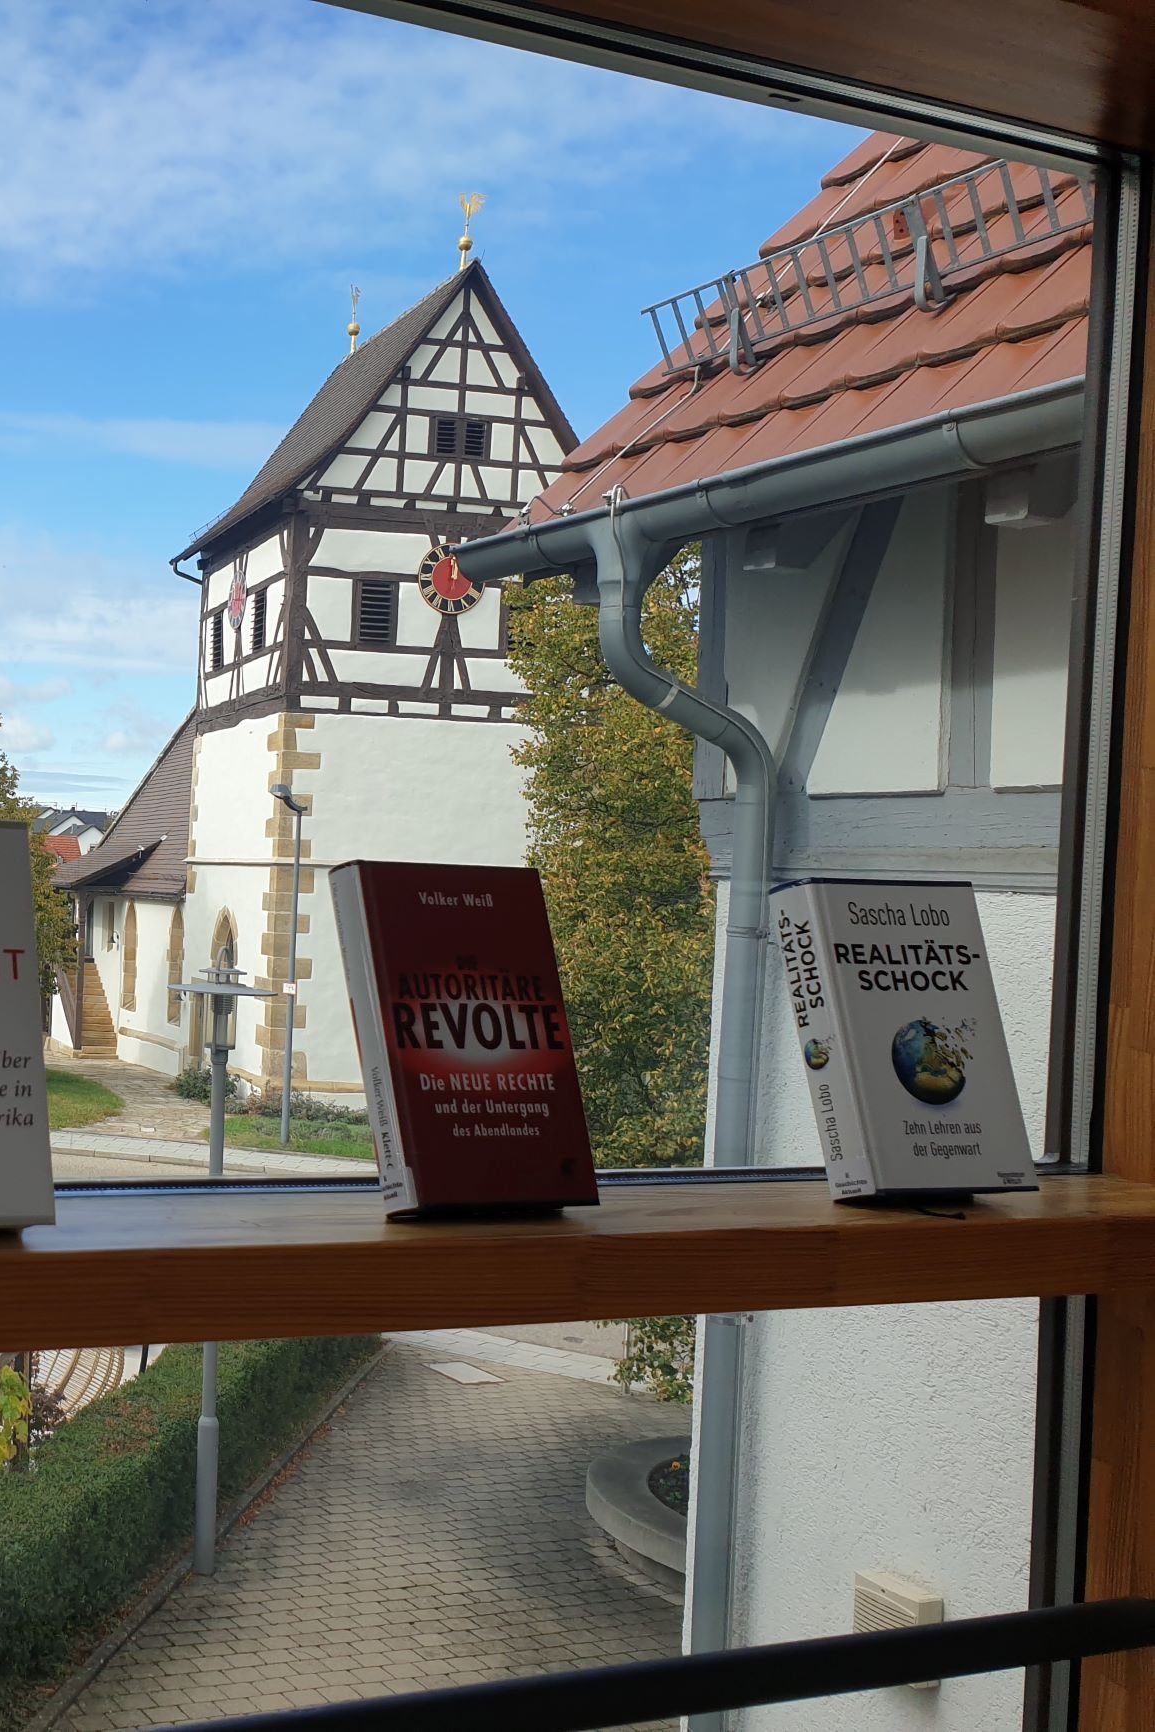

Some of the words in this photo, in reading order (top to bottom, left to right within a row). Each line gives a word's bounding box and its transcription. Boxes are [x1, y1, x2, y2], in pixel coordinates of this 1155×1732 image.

[418, 891, 459, 907] Volker
[462, 893, 494, 908] Weiß
[848, 901, 907, 927] Sascha
[909, 904, 951, 927] Lobo
[794, 919, 826, 1010] SCHOCK
[833, 940, 981, 966] REALITÄTS-
[778, 909, 811, 1029] REALITÄTS-
[858, 969, 969, 992] SCHOCK
[398, 968, 545, 1002] AUTORITÄRE
[392, 1002, 565, 1051] REVOLTE
[14, 1080, 33, 1099] in
[419, 1073, 446, 1092] Die
[450, 1073, 493, 1092] NEUE
[497, 1073, 556, 1092] RECHTE
[434, 1100, 459, 1115] und
[462, 1100, 482, 1115] der
[485, 1100, 550, 1118] Untergang
[819, 1083, 834, 1113] Lobo
[452, 1123, 471, 1138] des
[473, 1123, 541, 1138] Abendlandes
[826, 1115, 844, 1162] Sascha
[904, 1120, 927, 1136] Zehn
[929, 1120, 962, 1136] Lehren
[964, 1122, 982, 1135] aus
[913, 1142, 928, 1158] der
[930, 1142, 982, 1160] Gegenwart
